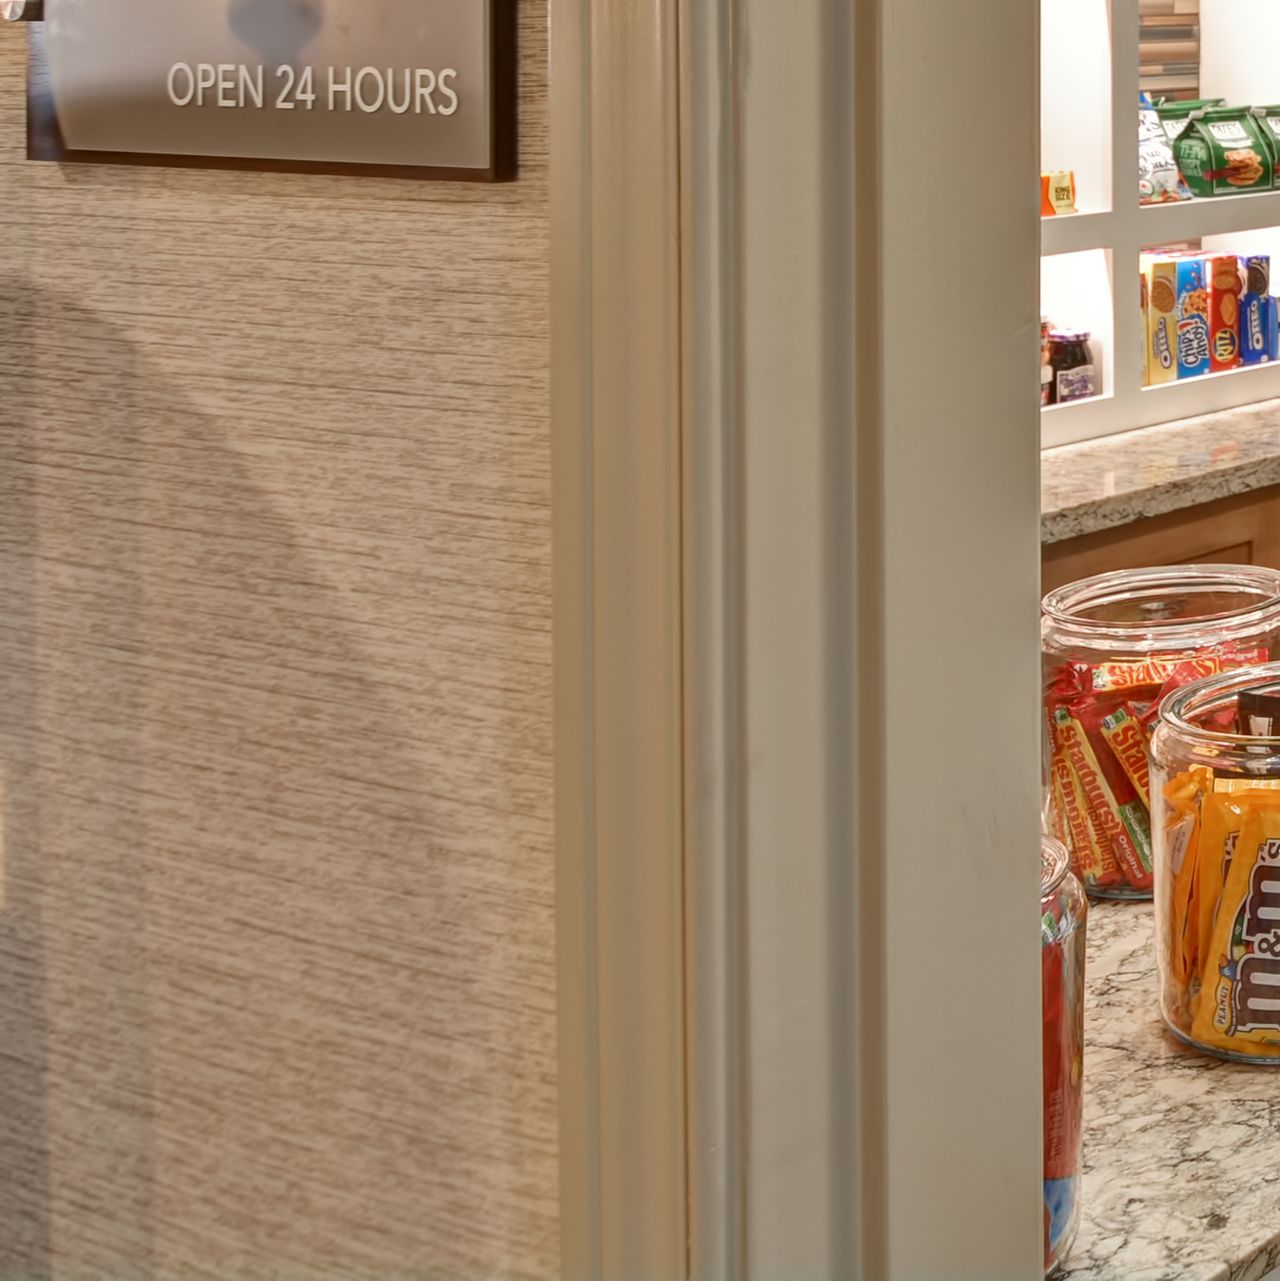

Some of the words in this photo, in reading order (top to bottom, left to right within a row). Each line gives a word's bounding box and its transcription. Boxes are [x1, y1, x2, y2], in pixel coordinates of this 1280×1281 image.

[166, 61, 265, 108] OPEN
[275, 63, 316, 110] 24
[328, 65, 458, 116] HOURS
[1159, 317, 1172, 369] OREO
[1250, 300, 1264, 350] OREO
[1216, 985, 1229, 1026] PEANUT
